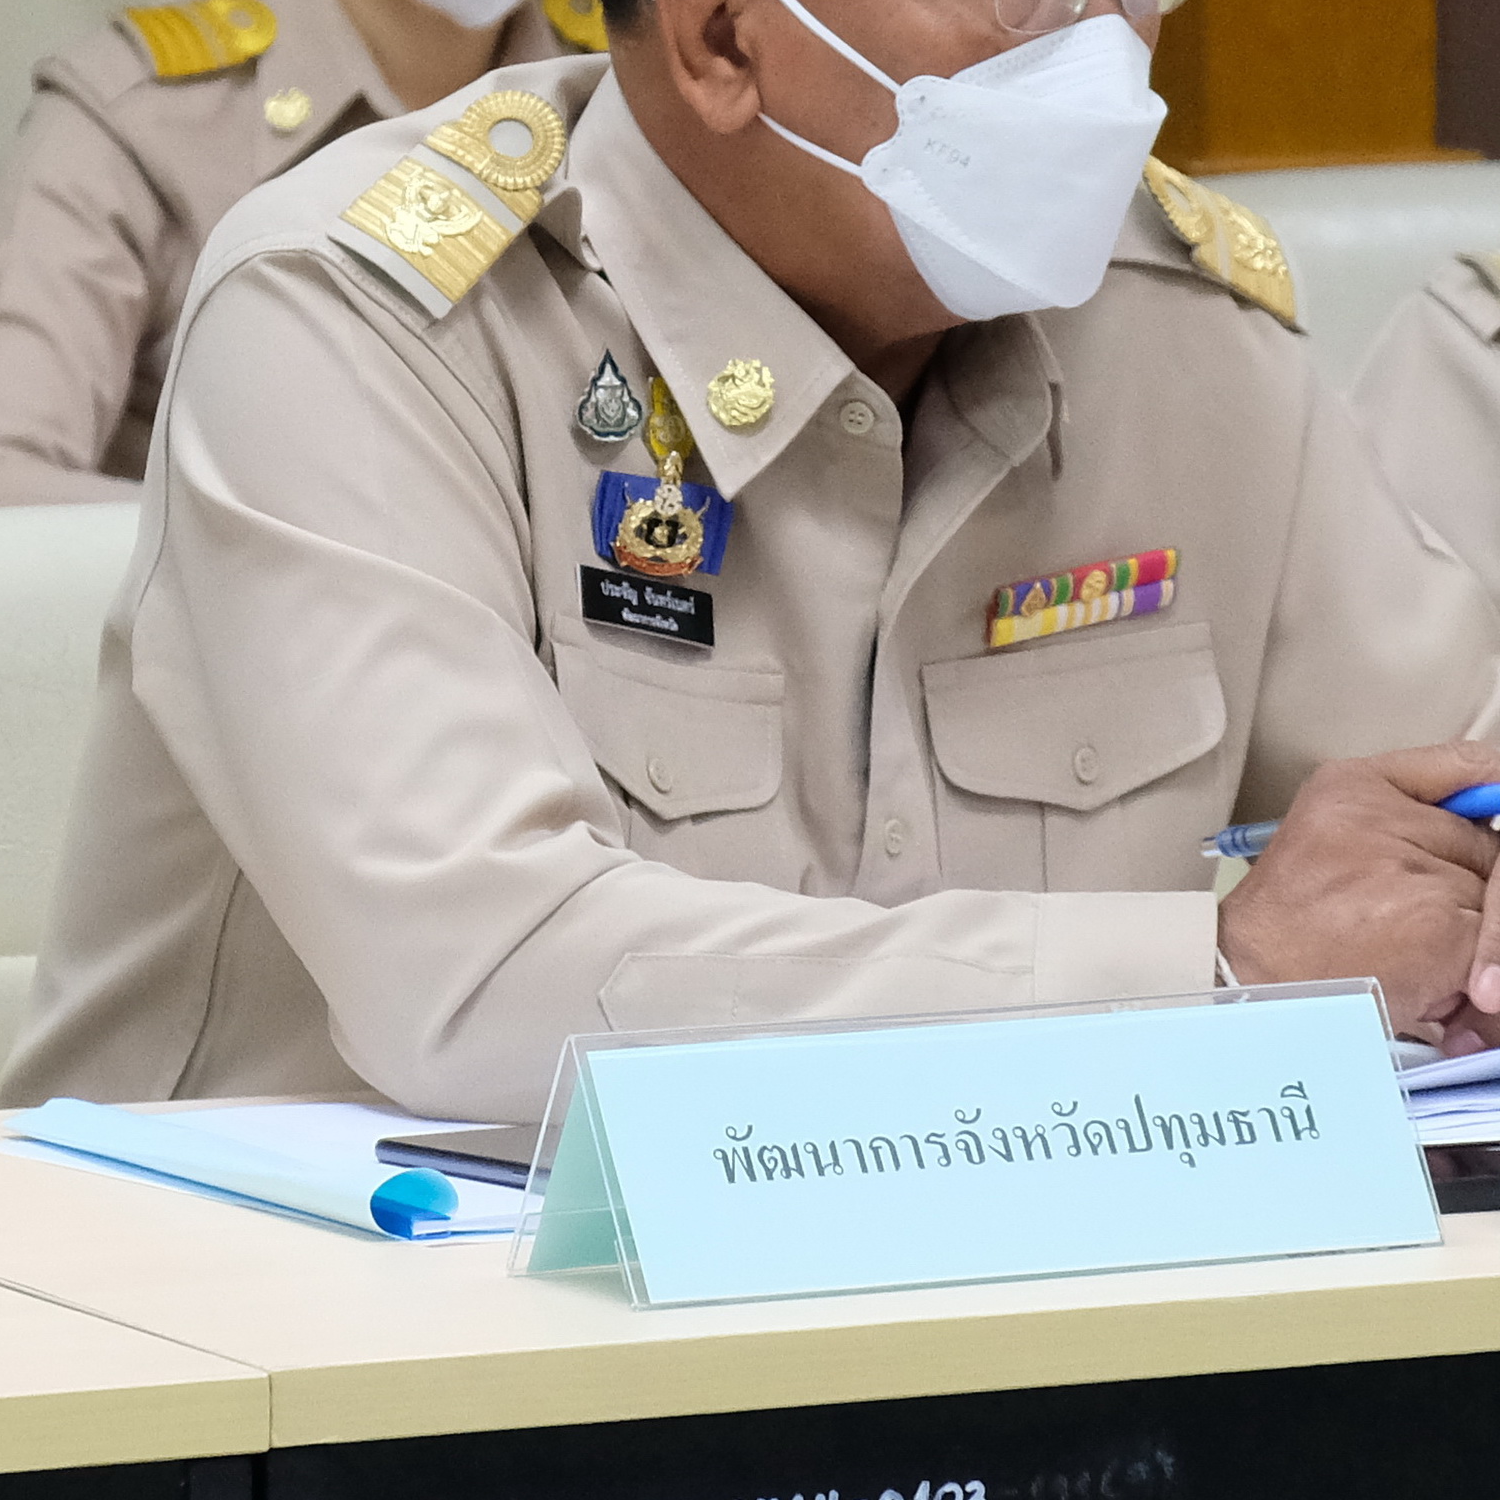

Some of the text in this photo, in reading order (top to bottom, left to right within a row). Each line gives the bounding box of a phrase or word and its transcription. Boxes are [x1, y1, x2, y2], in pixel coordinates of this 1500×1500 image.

[924, 138, 971, 168] KF94
[713, 1081, 1322, 1186] พัฒนาการจังหวัดปทุมธานี
